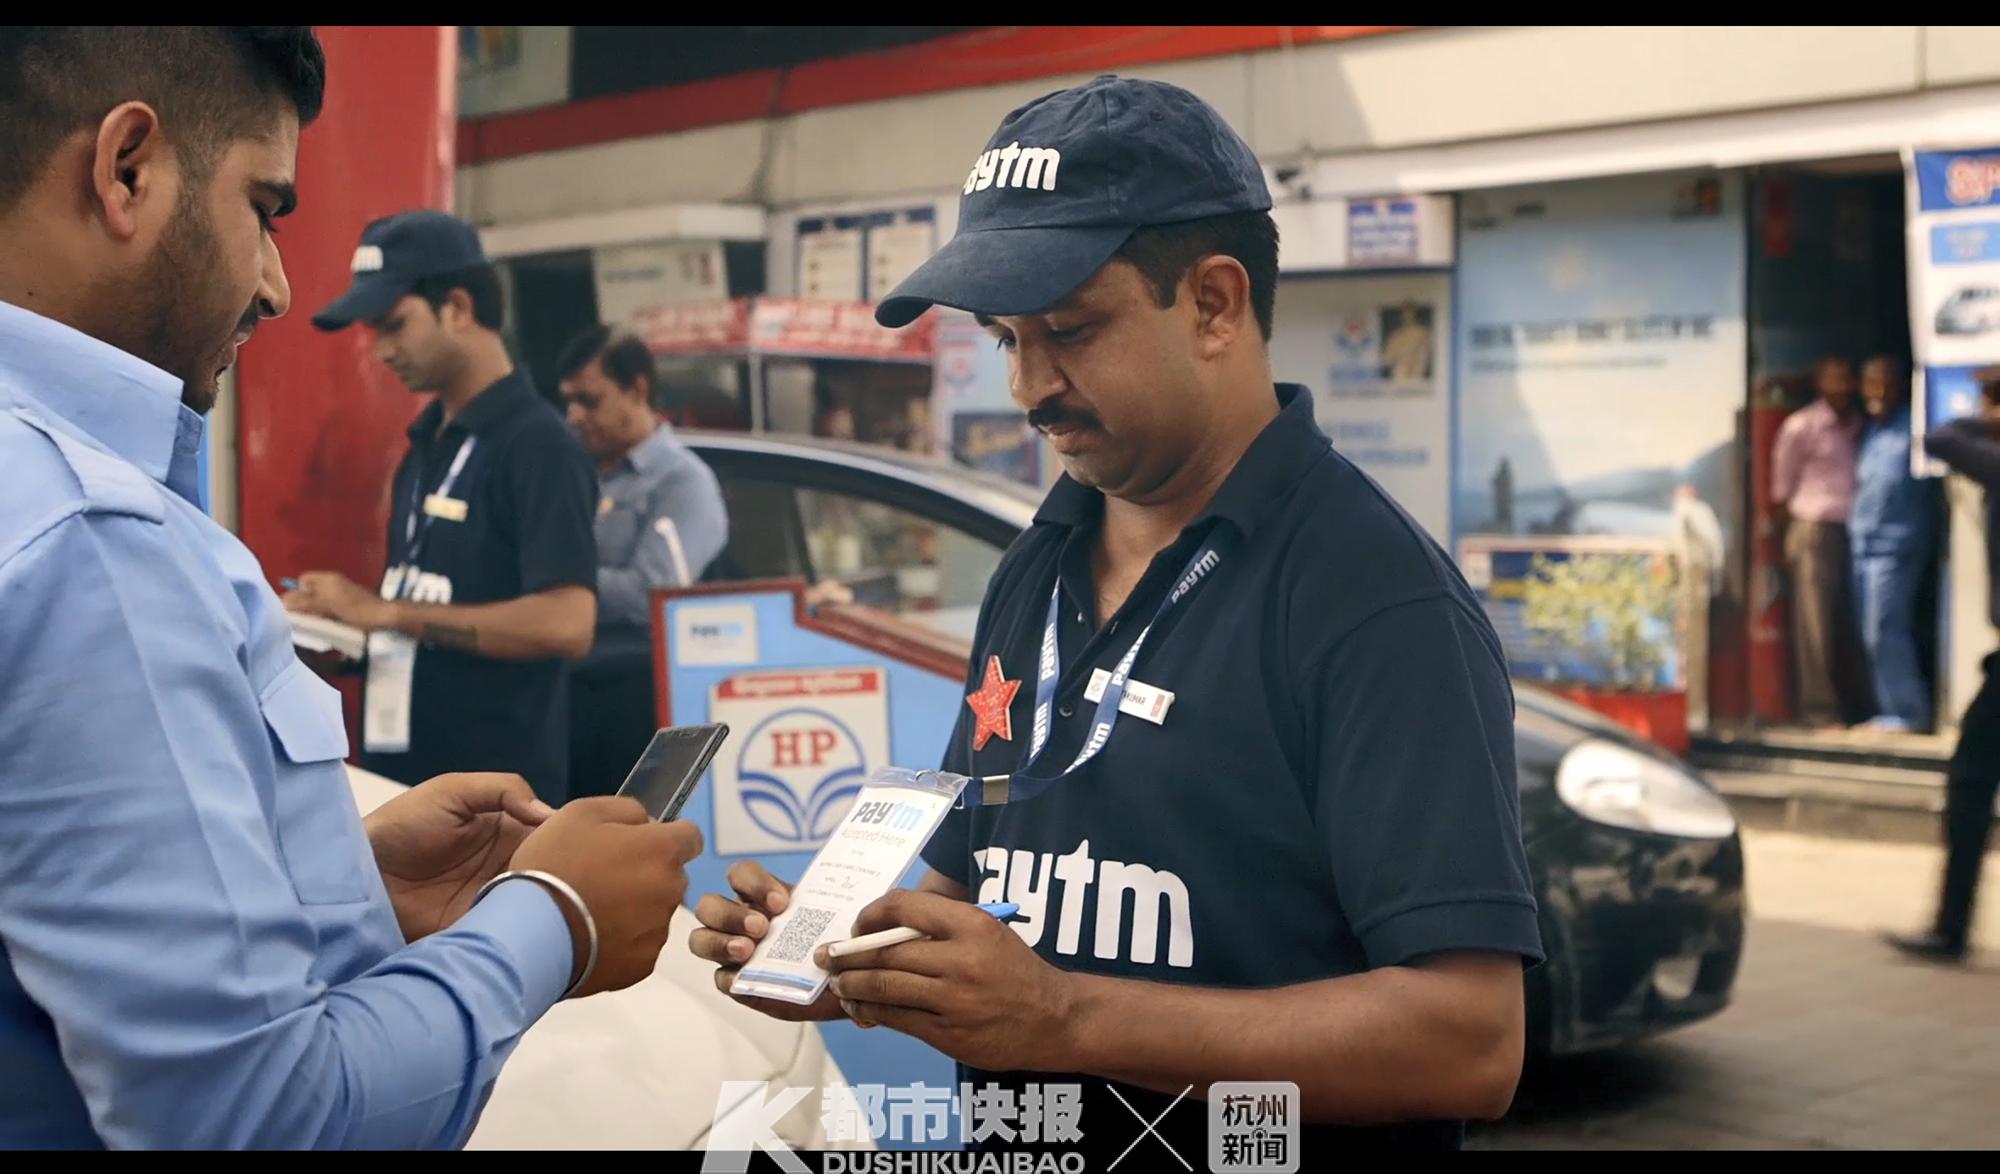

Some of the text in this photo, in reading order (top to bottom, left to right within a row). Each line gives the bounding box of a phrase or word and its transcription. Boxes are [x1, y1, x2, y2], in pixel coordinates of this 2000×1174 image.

[963, 141, 1060, 195] aytm
[1172, 549, 1221, 604] paytm
[769, 730, 837, 769] HP
[849, 801, 924, 832] paytm
[973, 839, 1194, 968] aytm
